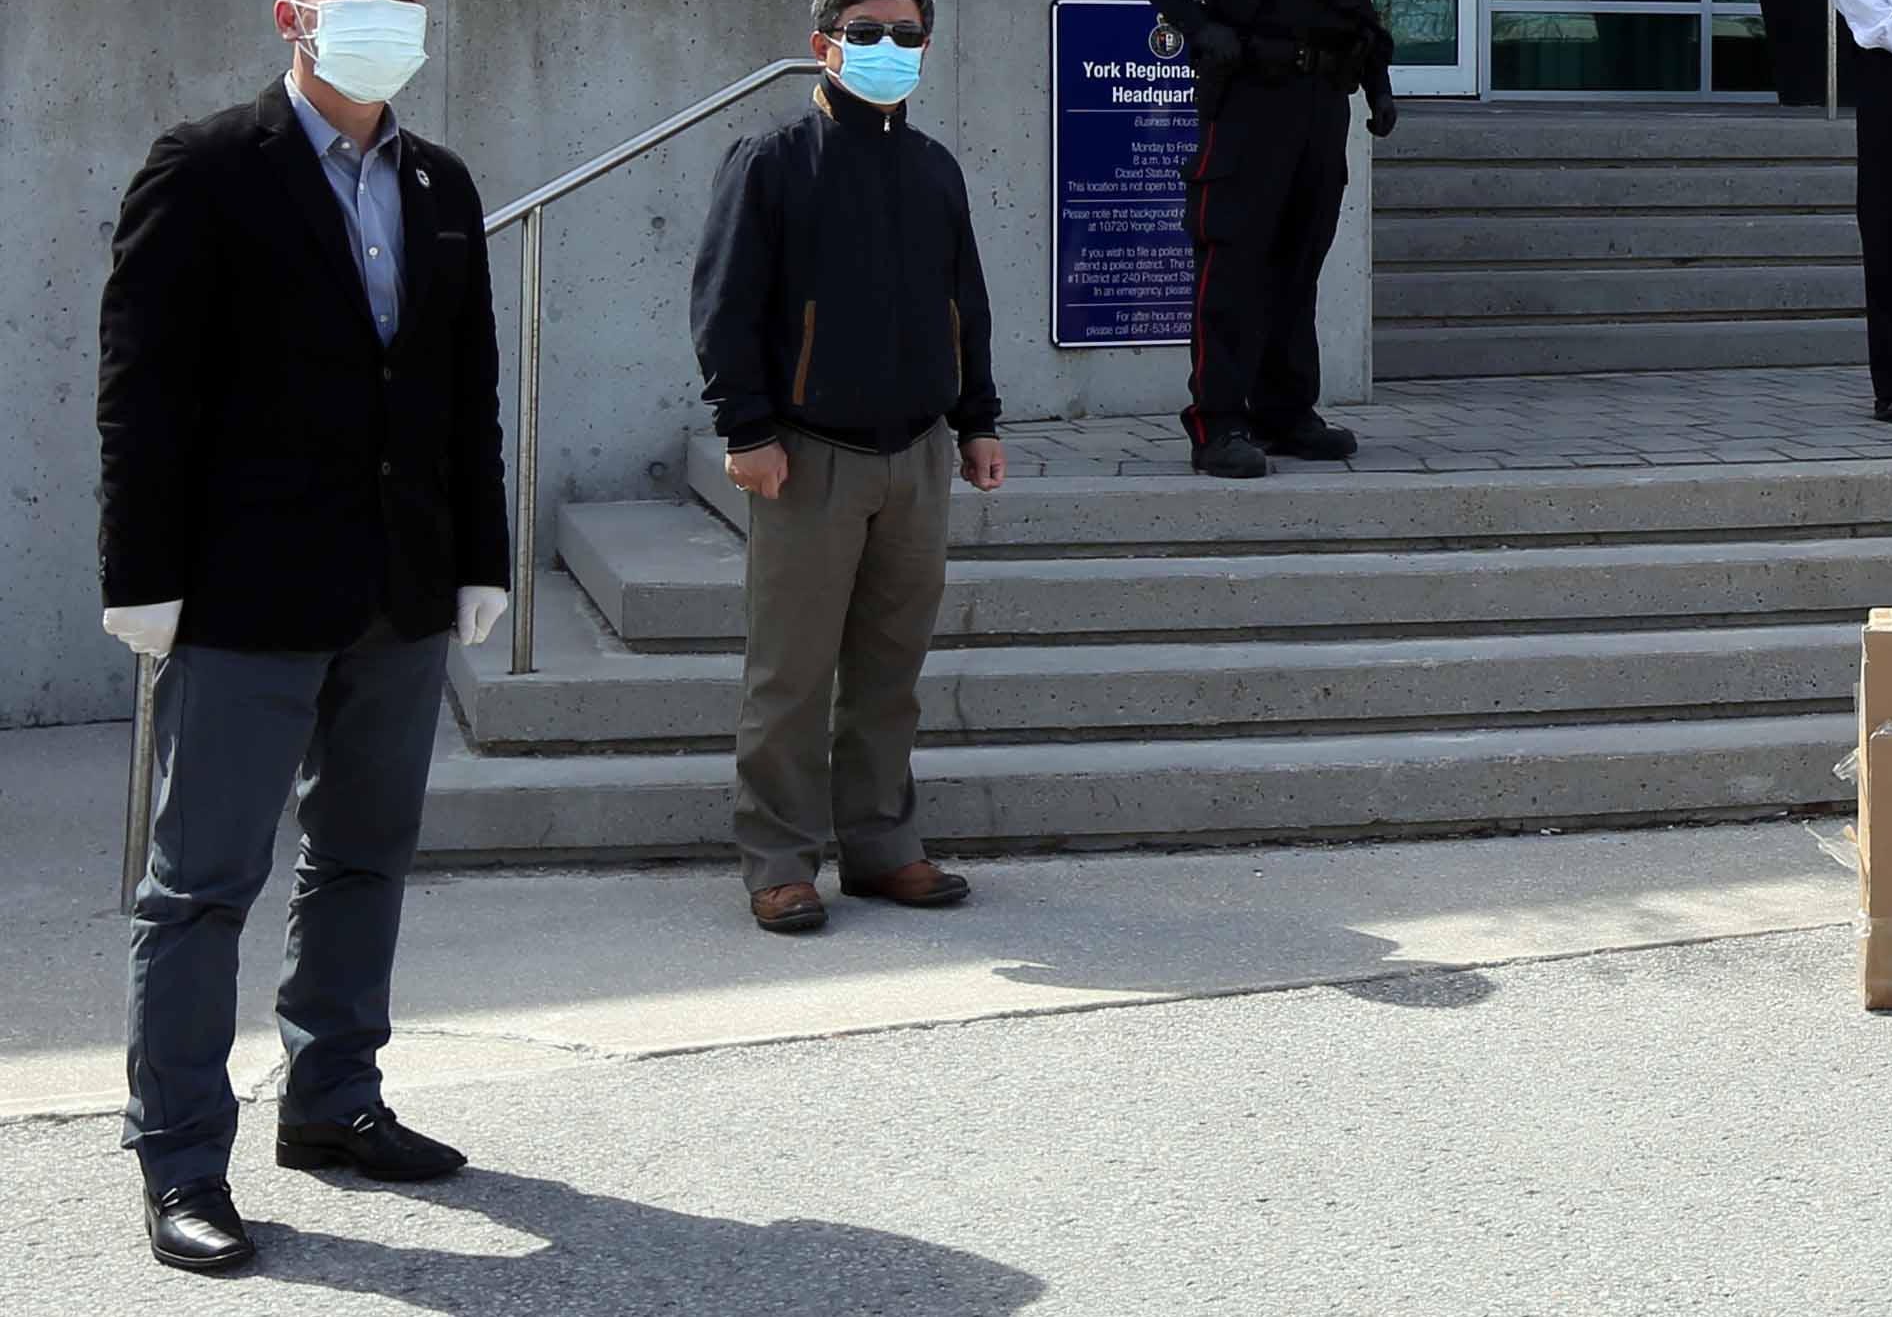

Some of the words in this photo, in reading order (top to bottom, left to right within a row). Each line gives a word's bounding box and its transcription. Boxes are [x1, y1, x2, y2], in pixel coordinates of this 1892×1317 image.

[1083, 61, 1120, 78] York
[1112, 86, 1194, 106] Headquart
[1134, 116, 1171, 127] Business
[1131, 142, 1164, 153] Monday
[1166, 142, 1175, 152] to
[1176, 141, 1198, 152] Frida
[1133, 155, 1139, 165] 8
[1162, 155, 1171, 164] to
[1173, 155, 1179, 165] 4
[1115, 167, 1143, 179] Closed
[1068, 181, 1085, 192] This
[1087, 181, 1119, 192] location
[1120, 182, 1128, 191] is
[1129, 181, 1143, 191] not
[1145, 182, 1167, 193] open
[1168, 181, 1177, 191] to
[1177, 180, 1186, 191] th
[1063, 208, 1090, 219] Please
[1092, 209, 1111, 218] note
[1112, 209, 1128, 218] that
[1130, 208, 1178, 219] background
[1088, 222, 1096, 231] at
[1100, 221, 1129, 231] 10720
[1130, 221, 1156, 232] Yonge
[1088, 249, 1104, 258] you
[1106, 247, 1125, 257] wish
[1127, 247, 1136, 256] to
[1151, 248, 1158, 256] a
[1158, 246, 1183, 258] police
[1074, 261, 1100, 271] attend
[1109, 261, 1134, 271] police
[1169, 259, 1185, 269] The
[1081, 273, 1110, 283] District
[1104, 288, 1115, 296] an
[1116, 311, 1129, 322] For
